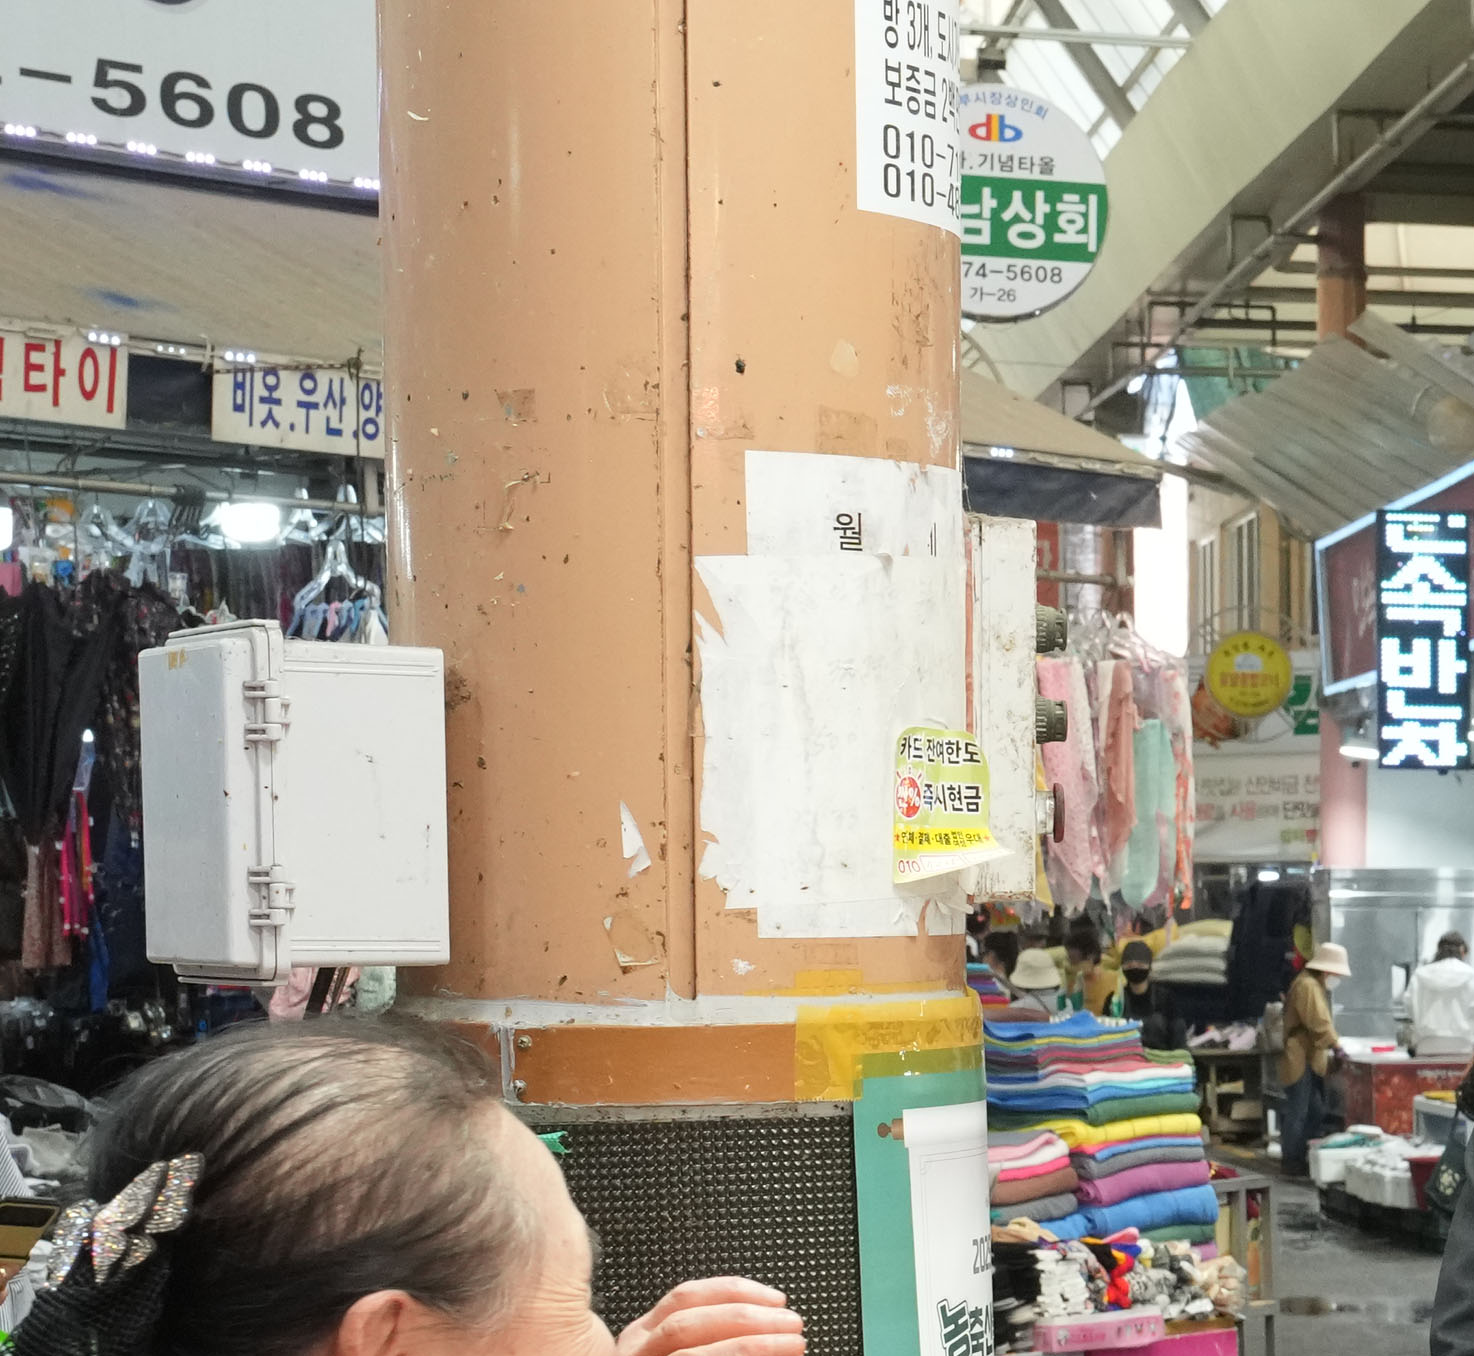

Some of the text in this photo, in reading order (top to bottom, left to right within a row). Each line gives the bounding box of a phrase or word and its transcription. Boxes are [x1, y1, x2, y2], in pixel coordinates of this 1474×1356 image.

[883, 58, 937, 121] 보증금
[0, 335, 119, 414] 타이
[832, 511, 863, 552] 월
[900, 735, 982, 765] 카드 잔여한도
[922, 783, 982, 813] 즉시현금
[897, 859, 921, 874] 010
